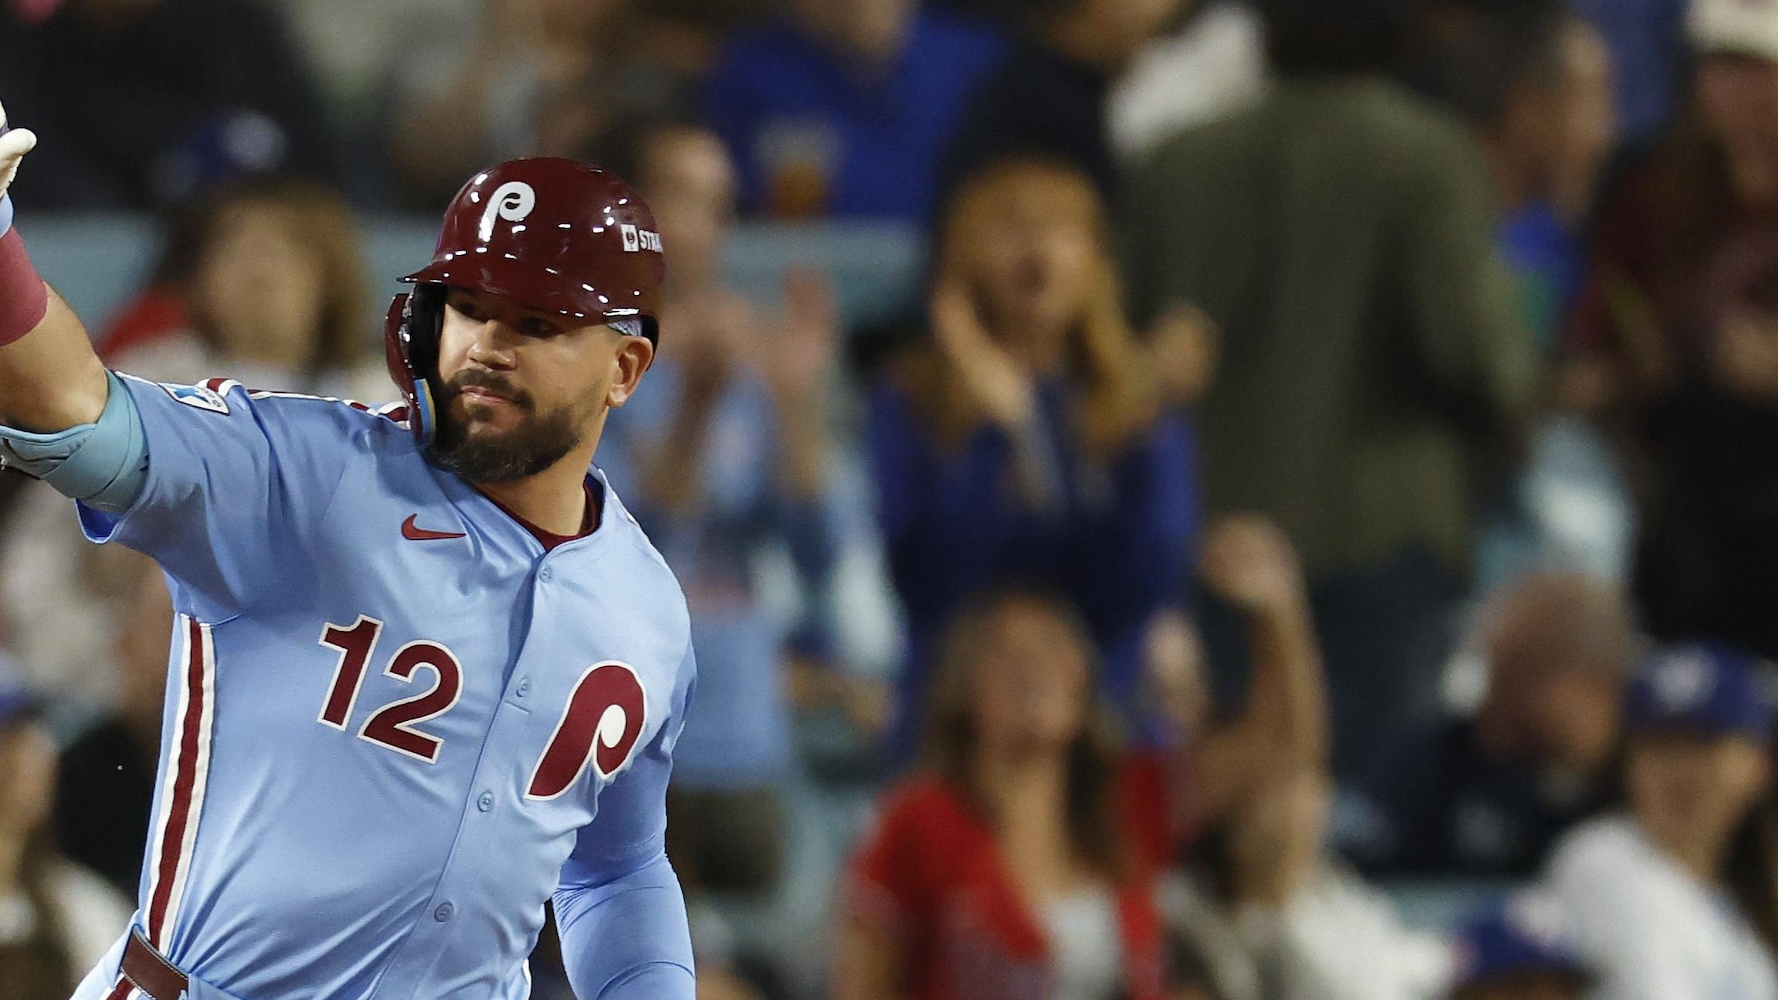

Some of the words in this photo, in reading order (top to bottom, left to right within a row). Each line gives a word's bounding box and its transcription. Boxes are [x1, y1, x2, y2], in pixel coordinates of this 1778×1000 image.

[478, 181, 536, 243] P
[317, 613, 464, 765] 12
[523, 659, 648, 801] P
